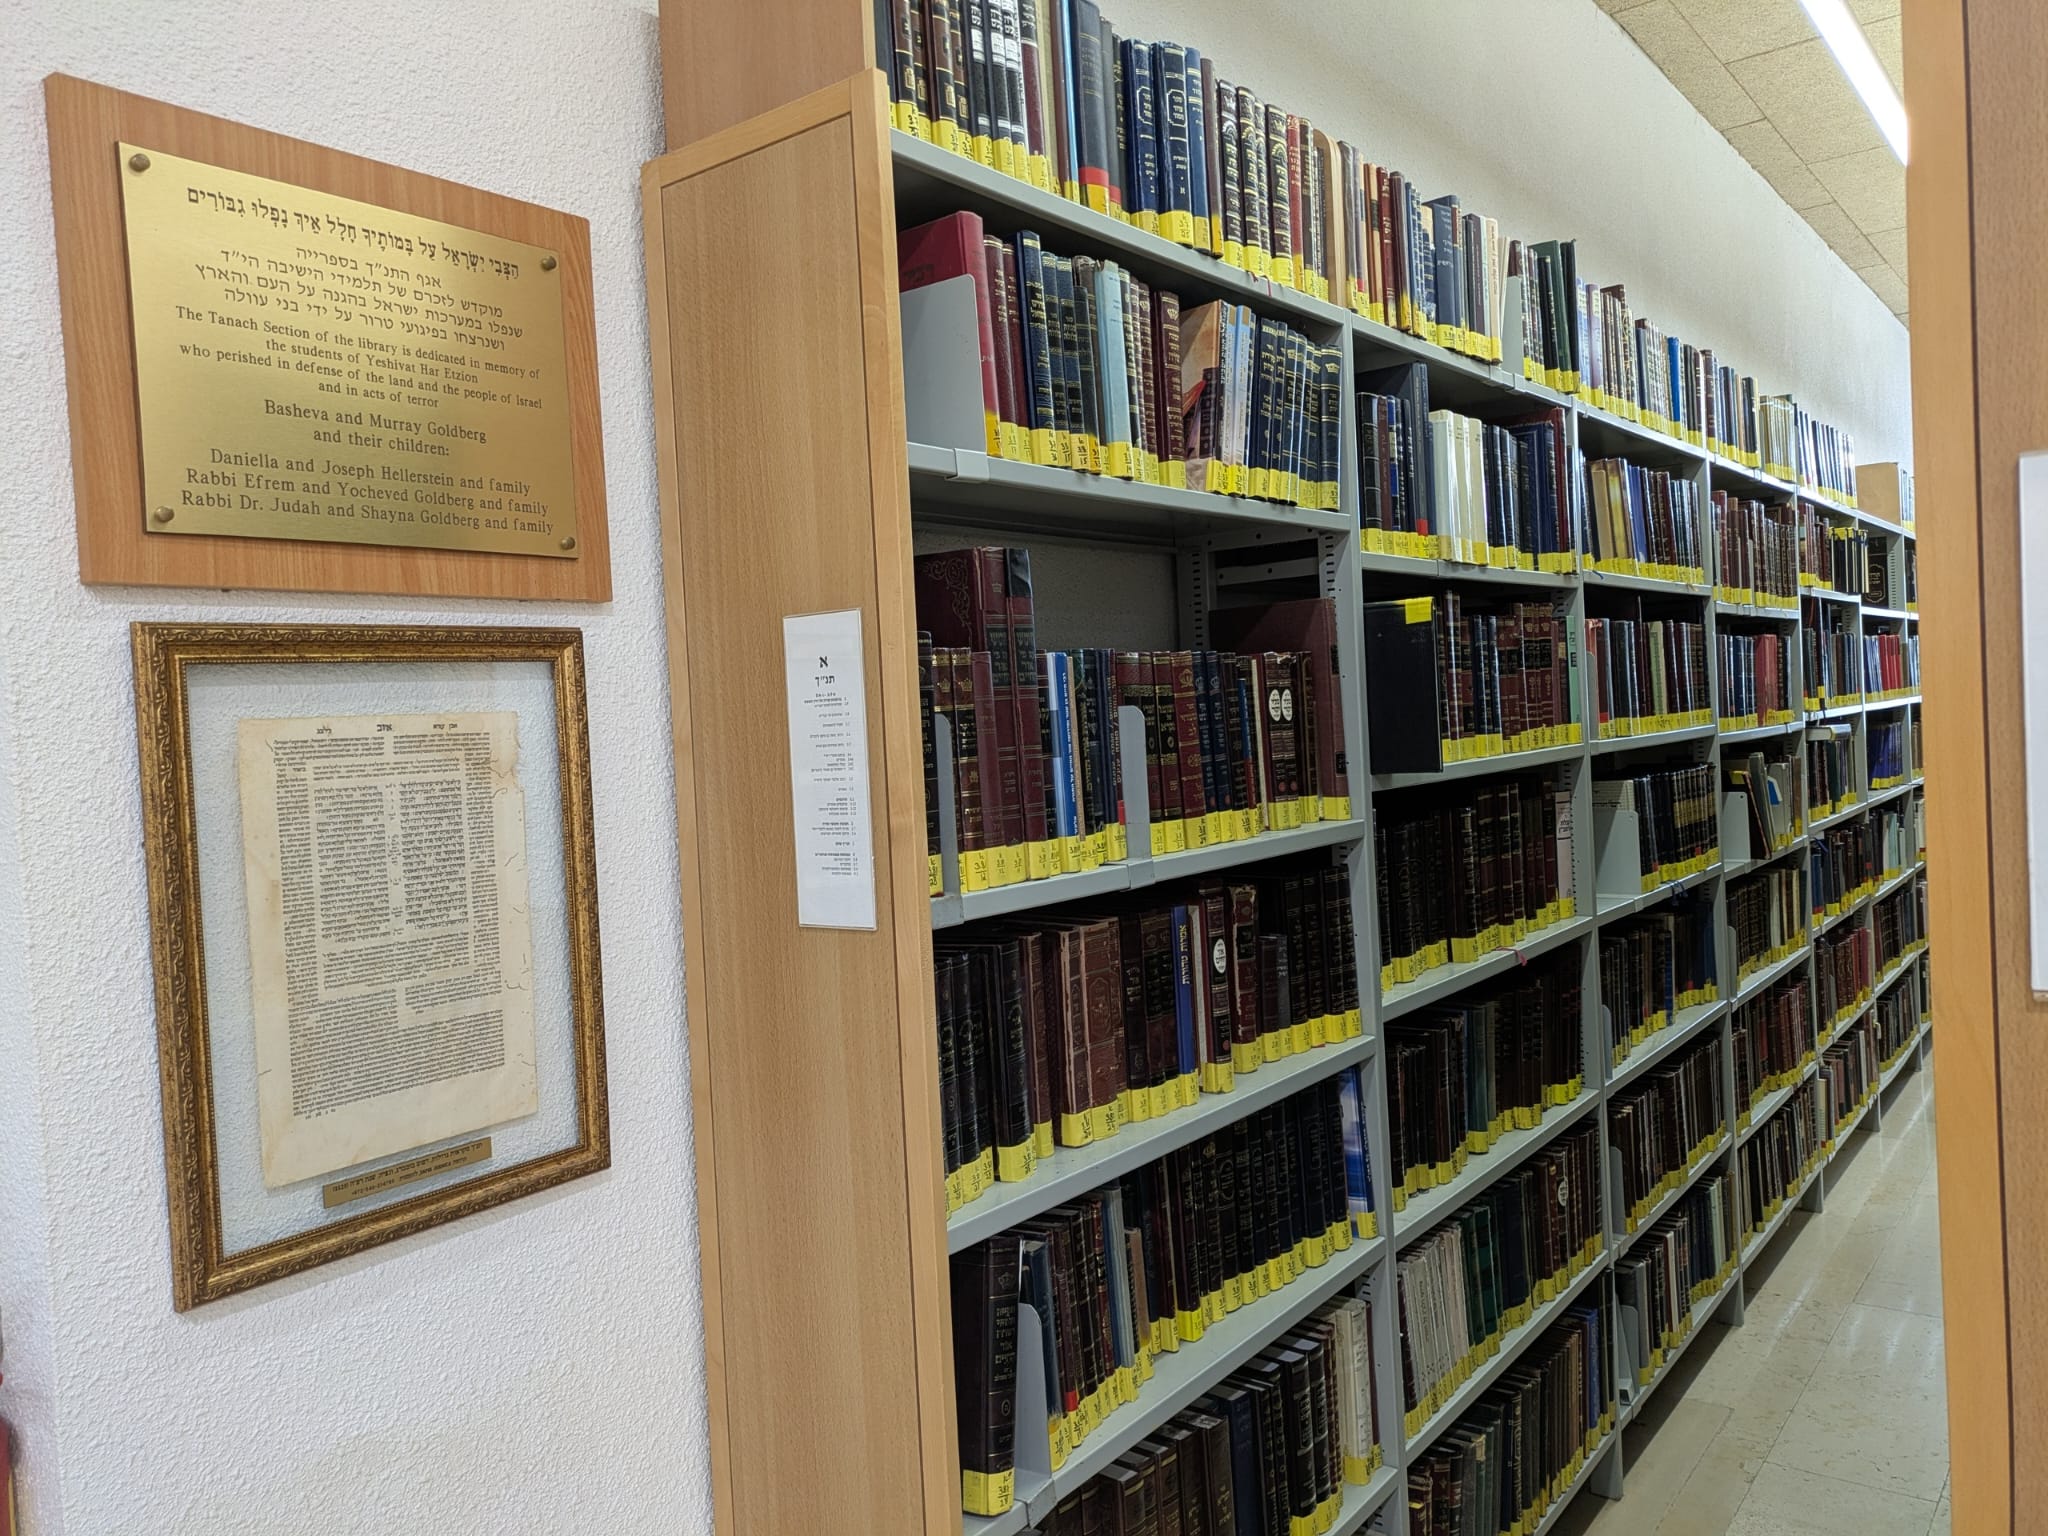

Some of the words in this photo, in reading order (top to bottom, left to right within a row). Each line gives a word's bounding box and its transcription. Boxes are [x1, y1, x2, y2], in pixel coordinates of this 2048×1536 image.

[296, 248, 358, 270] בספרייה
[195, 264, 249, 285] והארץ
[267, 259, 324, 281] הישיבה
[257, 276, 290, 293] העם
[297, 281, 315, 297] על
[331, 272, 382, 292] תלמידי
[388, 282, 407, 297] של
[417, 272, 442, 289] אגף
[224, 288, 268, 306] עוולה
[276, 298, 299, 312] בני
[323, 289, 367, 307] בהגנה
[374, 296, 418, 315] ישראל
[414, 290, 455, 307] לזכרם
[307, 304, 327, 317] ידי
[334, 306, 352, 322] על
[461, 299, 503, 318] מוקדש
[360, 314, 393, 329] טרור
[425, 309, 482, 330] במערכות
[400, 321, 447, 340] בפיגועי
[489, 321, 523, 338] שנפלו
[176, 305, 203, 321] The
[208, 311, 258, 331] Tanach
[263, 321, 310, 340] Section
[315, 331, 329, 342] of
[334, 333, 354, 346] the
[358, 337, 398, 356] library
[402, 344, 411, 356] is
[415, 347, 466, 366] dedicated
[470, 357, 480, 369] in
[485, 361, 526, 378] memory
[529, 368, 540, 380] of
[454, 331, 505, 351] ושנרצחו
[266, 339, 287, 352] the
[291, 343, 343, 361] students
[347, 353, 361, 364] of
[366, 354, 416, 373] Yeshivat
[421, 363, 440, 377] Har
[444, 368, 479, 384] Etzion
[179, 344, 211, 358] who
[216, 349, 272, 367] perished
[277, 357, 291, 369] in
[295, 360, 343, 377] defense
[347, 369, 361, 380] of
[367, 371, 385, 384] the
[389, 375, 414, 389] land
[418, 379, 438, 393] and
[443, 383, 460, 396] the
[464, 388, 497, 402] people
[500, 392, 512, 404] of
[516, 395, 543, 409] Israel
[318, 382, 341, 394] and
[346, 384, 358, 396] in
[363, 388, 385, 400] acts
[389, 391, 403, 403] of
[407, 395, 440, 408] terror
[264, 399, 329, 422] Basheva
[335, 411, 363, 426] and
[369, 413, 422, 436] Murray
[427, 422, 487, 444] Goldberg
[313, 430, 342, 443] and
[348, 432, 383, 448] their
[388, 439, 450, 457] children:
[210, 448, 279, 470] Daniella
[286, 458, 315, 473] and
[321, 460, 375, 480] Joseph
[381, 466, 454, 487] Hellerstein
[460, 476, 484, 490] and
[489, 478, 532, 497] family
[186, 468, 237, 488] Rabbi
[245, 473, 295, 492] Efrem
[302, 481, 331, 495] and
[337, 482, 408, 502] Yocheved
[414, 489, 474, 511] Goldberg
[479, 498, 502, 511] and
[508, 499, 549, 517] family
[182, 489, 232, 509] Rabbi
[240, 495, 264, 511] Dr.
[270, 497, 321, 516] Judah
[327, 504, 355, 518] and
[361, 505, 415, 524] Shayna
[420, 510, 480, 530] Goldberg
[485, 517, 508, 530] and
[513, 518, 554, 536] family
[819, 656, 828, 668] א
